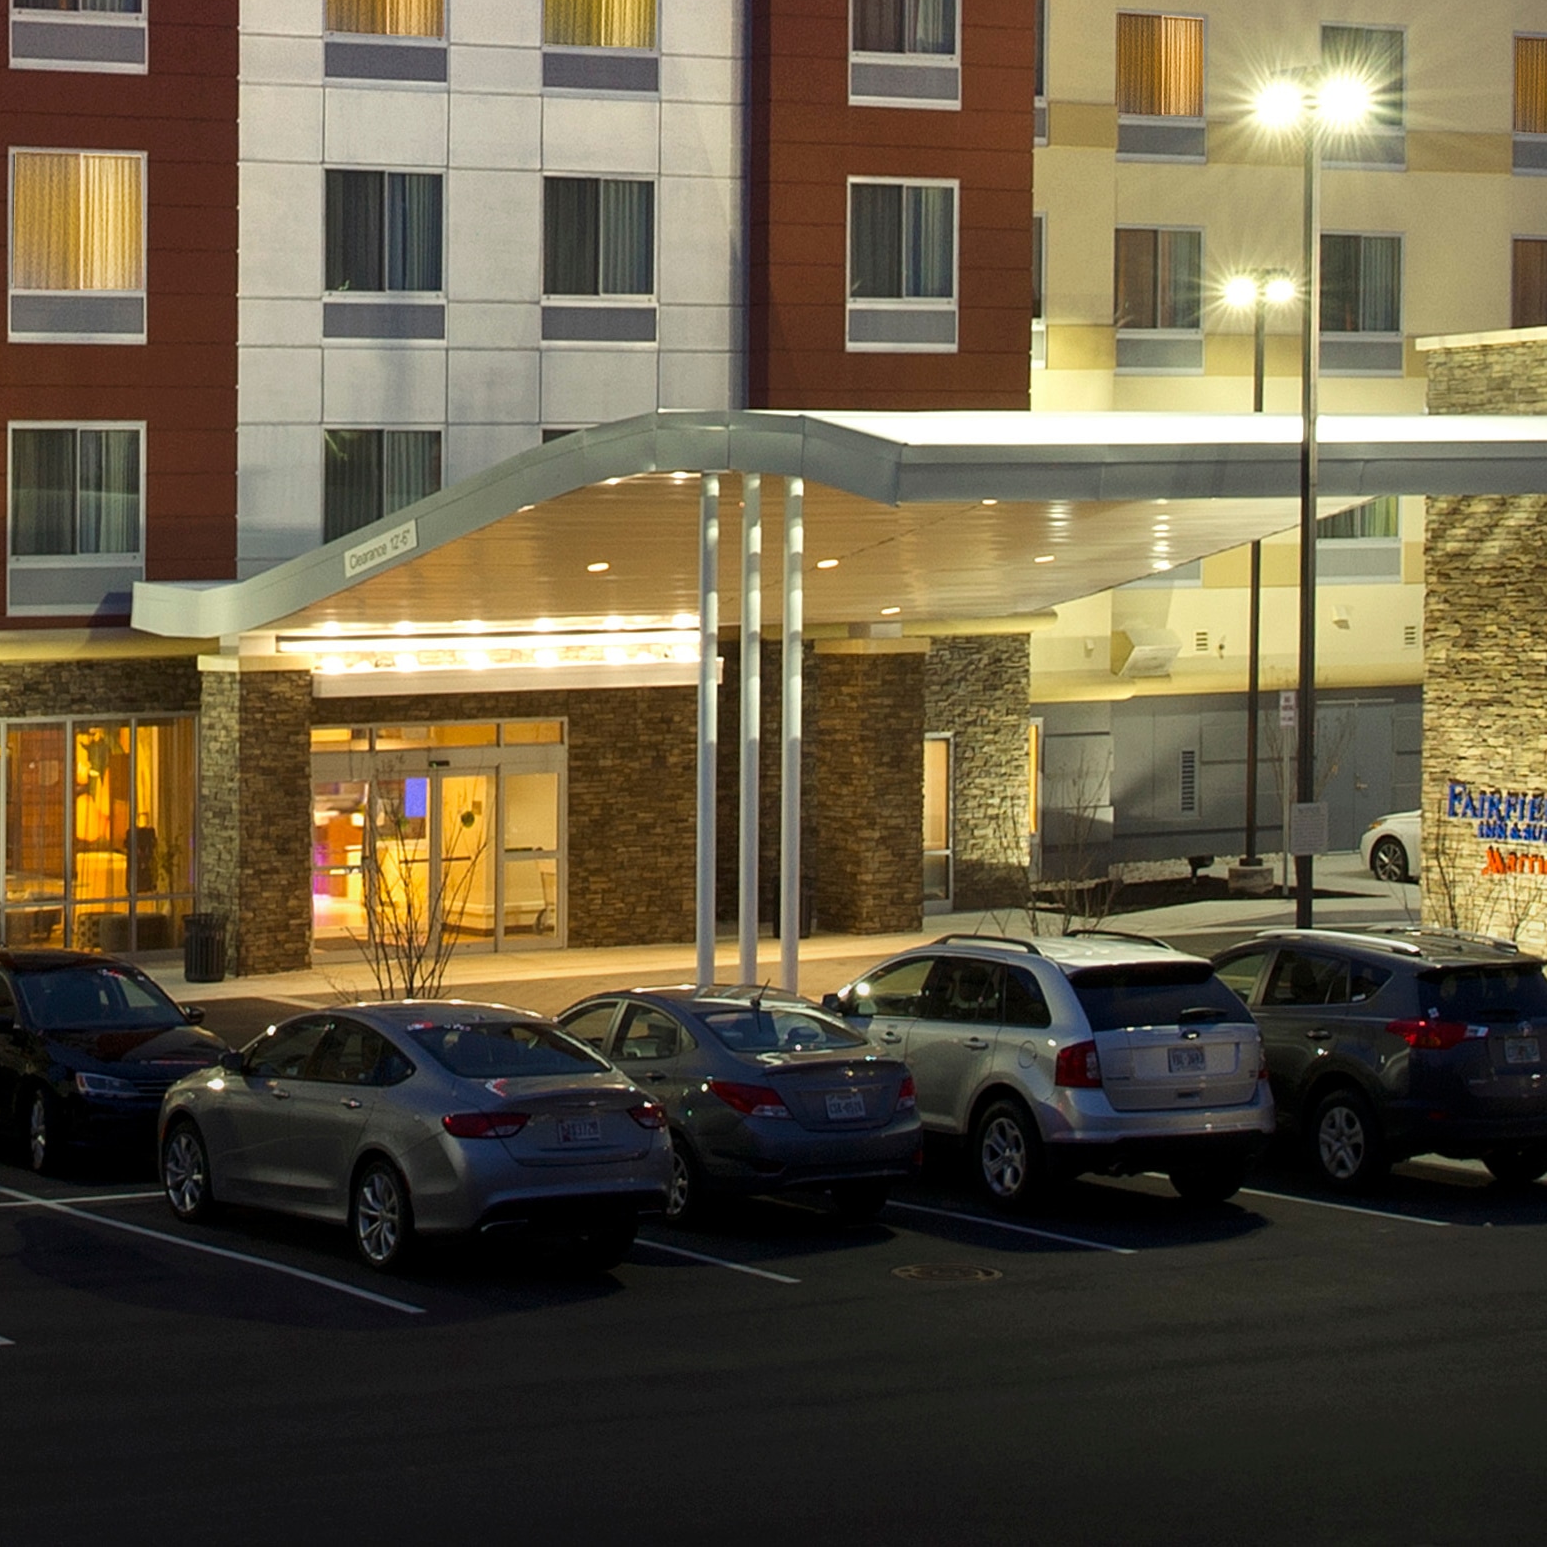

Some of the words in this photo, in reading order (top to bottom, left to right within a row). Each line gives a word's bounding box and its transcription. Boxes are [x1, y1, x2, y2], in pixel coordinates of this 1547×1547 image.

[1447, 782, 1547, 824] FAIRFIE
[1478, 821, 1507, 840] INN
[1510, 822, 1522, 841] &
[1480, 845, 1547, 876] Marri
